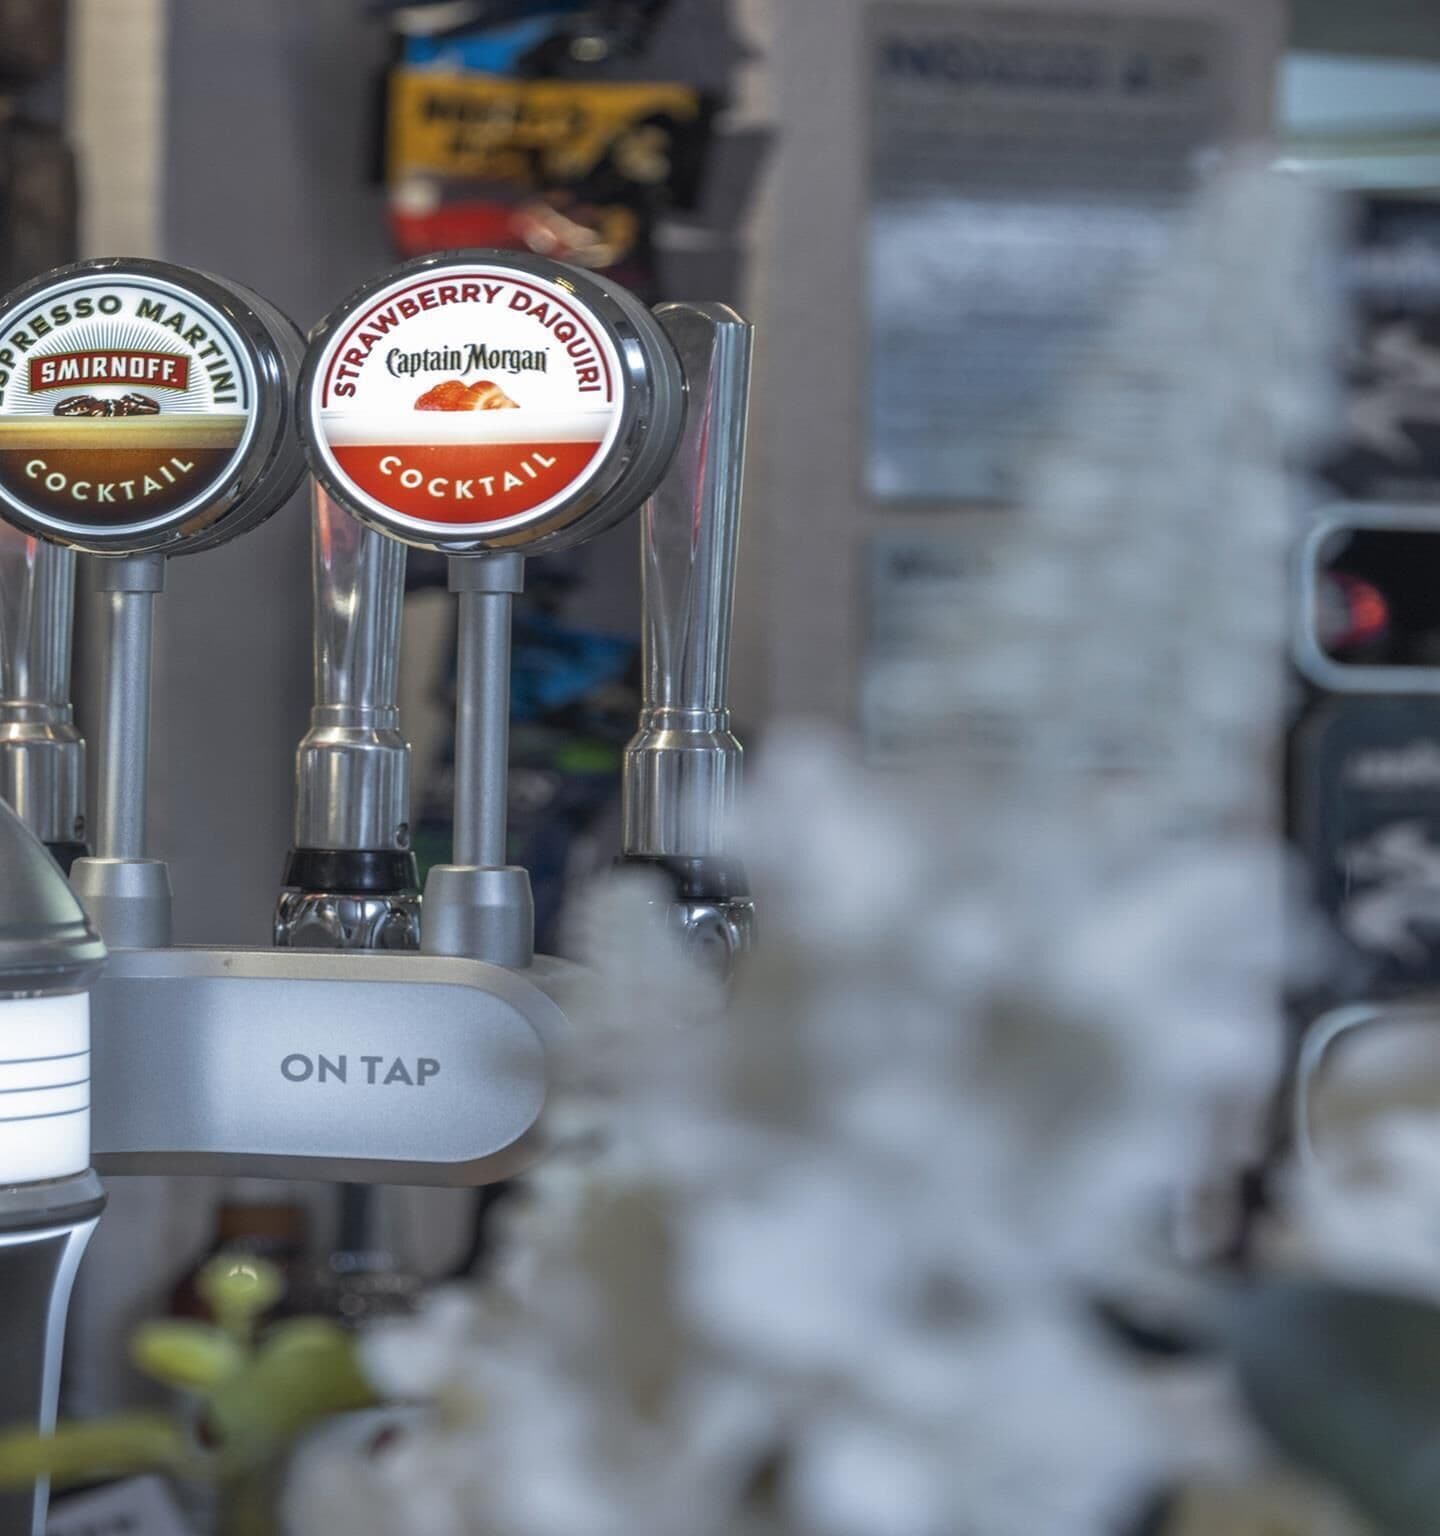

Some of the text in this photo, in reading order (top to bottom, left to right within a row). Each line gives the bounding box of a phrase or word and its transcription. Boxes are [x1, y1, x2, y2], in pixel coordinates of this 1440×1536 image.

[136, 299, 237, 404] MARTINI
[335, 284, 601, 397] STRAWBERRY DAIQUIRI
[386, 344, 548, 377] Captain Morgan
[26, 457, 194, 502] COCKTAIL
[380, 452, 556, 499] COCKTAIL
[280, 1053, 440, 1086] ON TAP
